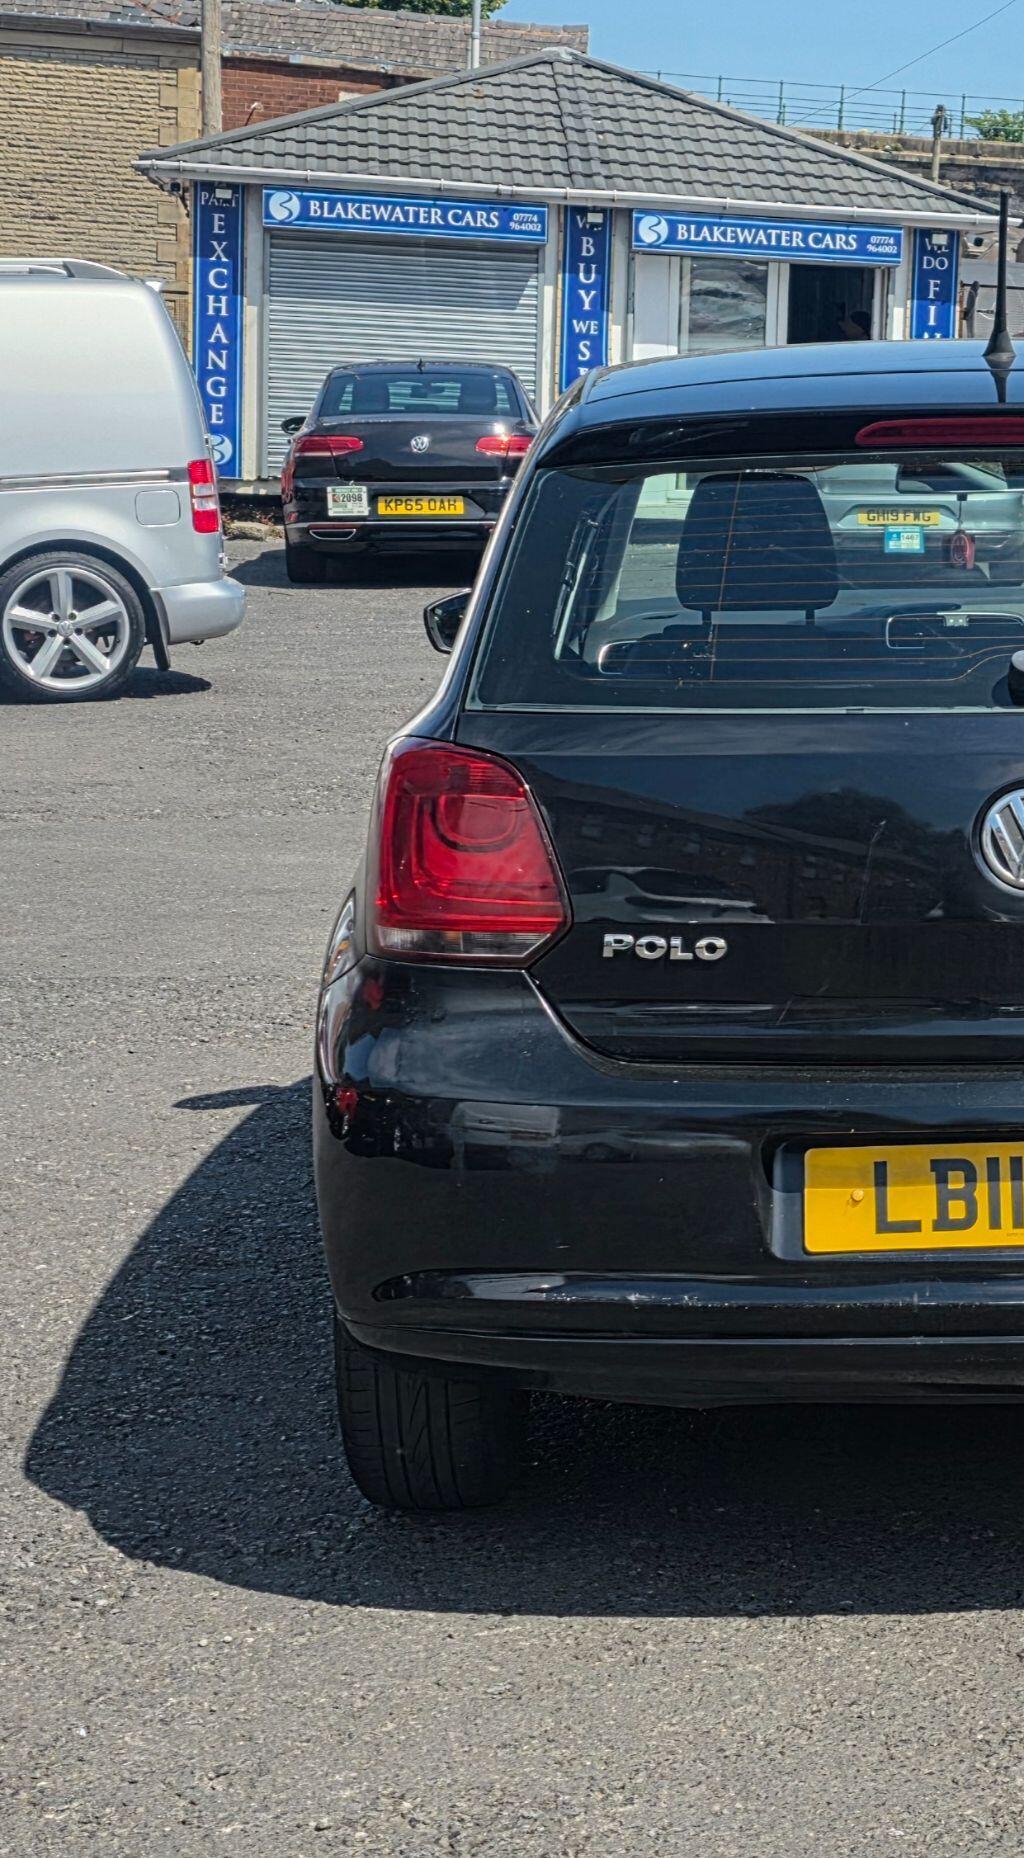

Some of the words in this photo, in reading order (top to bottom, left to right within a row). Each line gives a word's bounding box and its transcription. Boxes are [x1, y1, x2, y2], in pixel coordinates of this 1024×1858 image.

[308, 200, 443, 224] BLAKEWATER
[447, 209, 499, 228] CARS
[512, 212, 538, 223] 07774
[509, 221, 542, 232] 964002
[676, 223, 804, 248] BLAKEWATER
[807, 231, 858, 251] CARS
[870, 235, 894, 245] 07774
[866, 244, 898, 254] 964002
[922, 256, 949, 270] DO
[577, 236, 598, 311] BUY
[206, 213, 230, 425] EXCHANGE
[572, 319, 599, 335] WE
[384, 498, 424, 512] KP65
[427, 498, 457, 512] OAH
[866, 508, 899, 522] GH19
[903, 509, 931, 522] FWG
[602, 933, 728, 961] POLO
